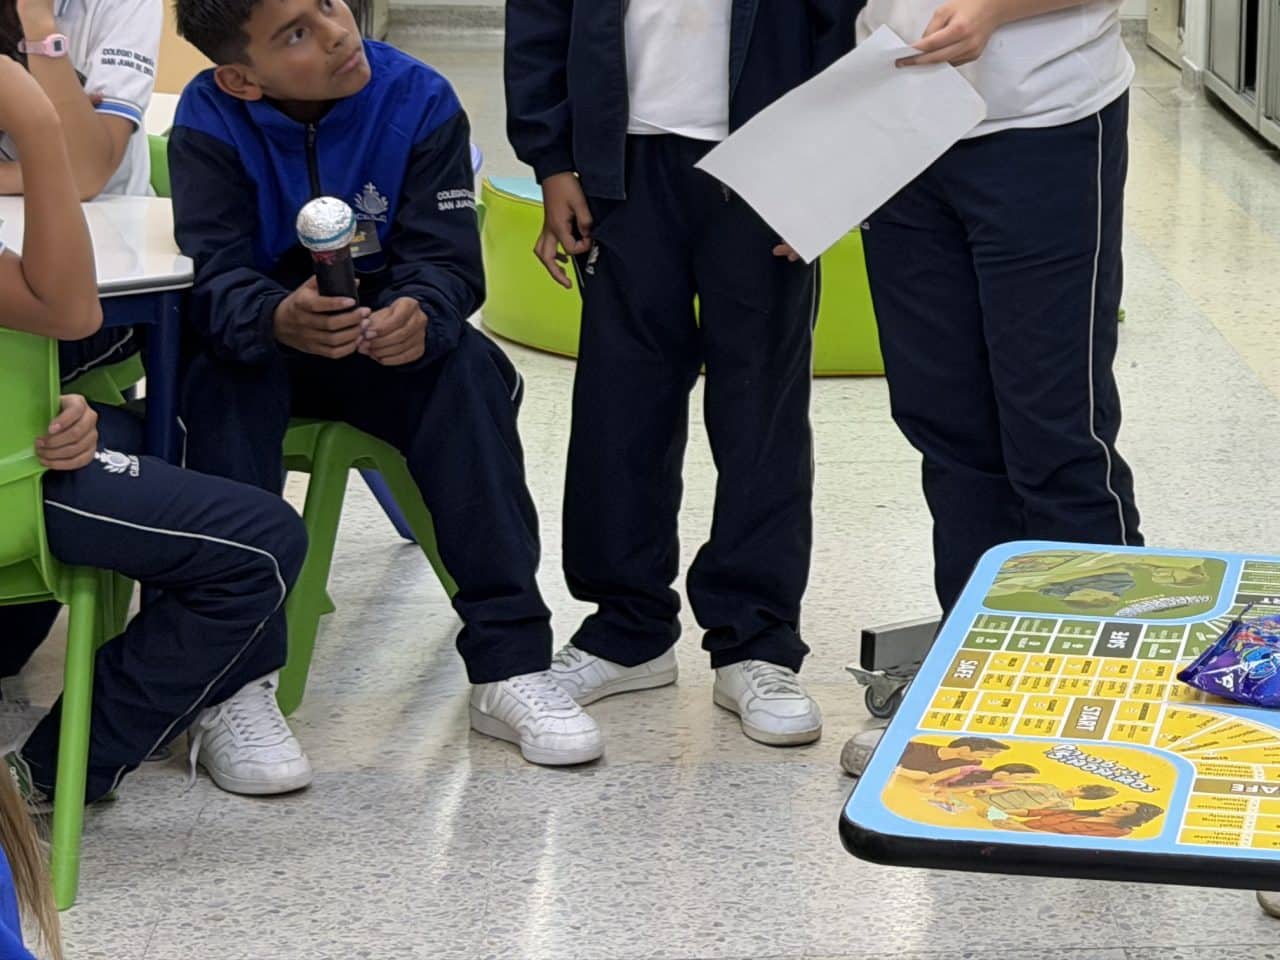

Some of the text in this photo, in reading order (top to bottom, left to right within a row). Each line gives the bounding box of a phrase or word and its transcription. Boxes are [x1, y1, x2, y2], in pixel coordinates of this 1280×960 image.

[1107, 631, 1130, 649] SAFE
[954, 659, 978, 679] SAFE
[1076, 705, 1102, 732] START
